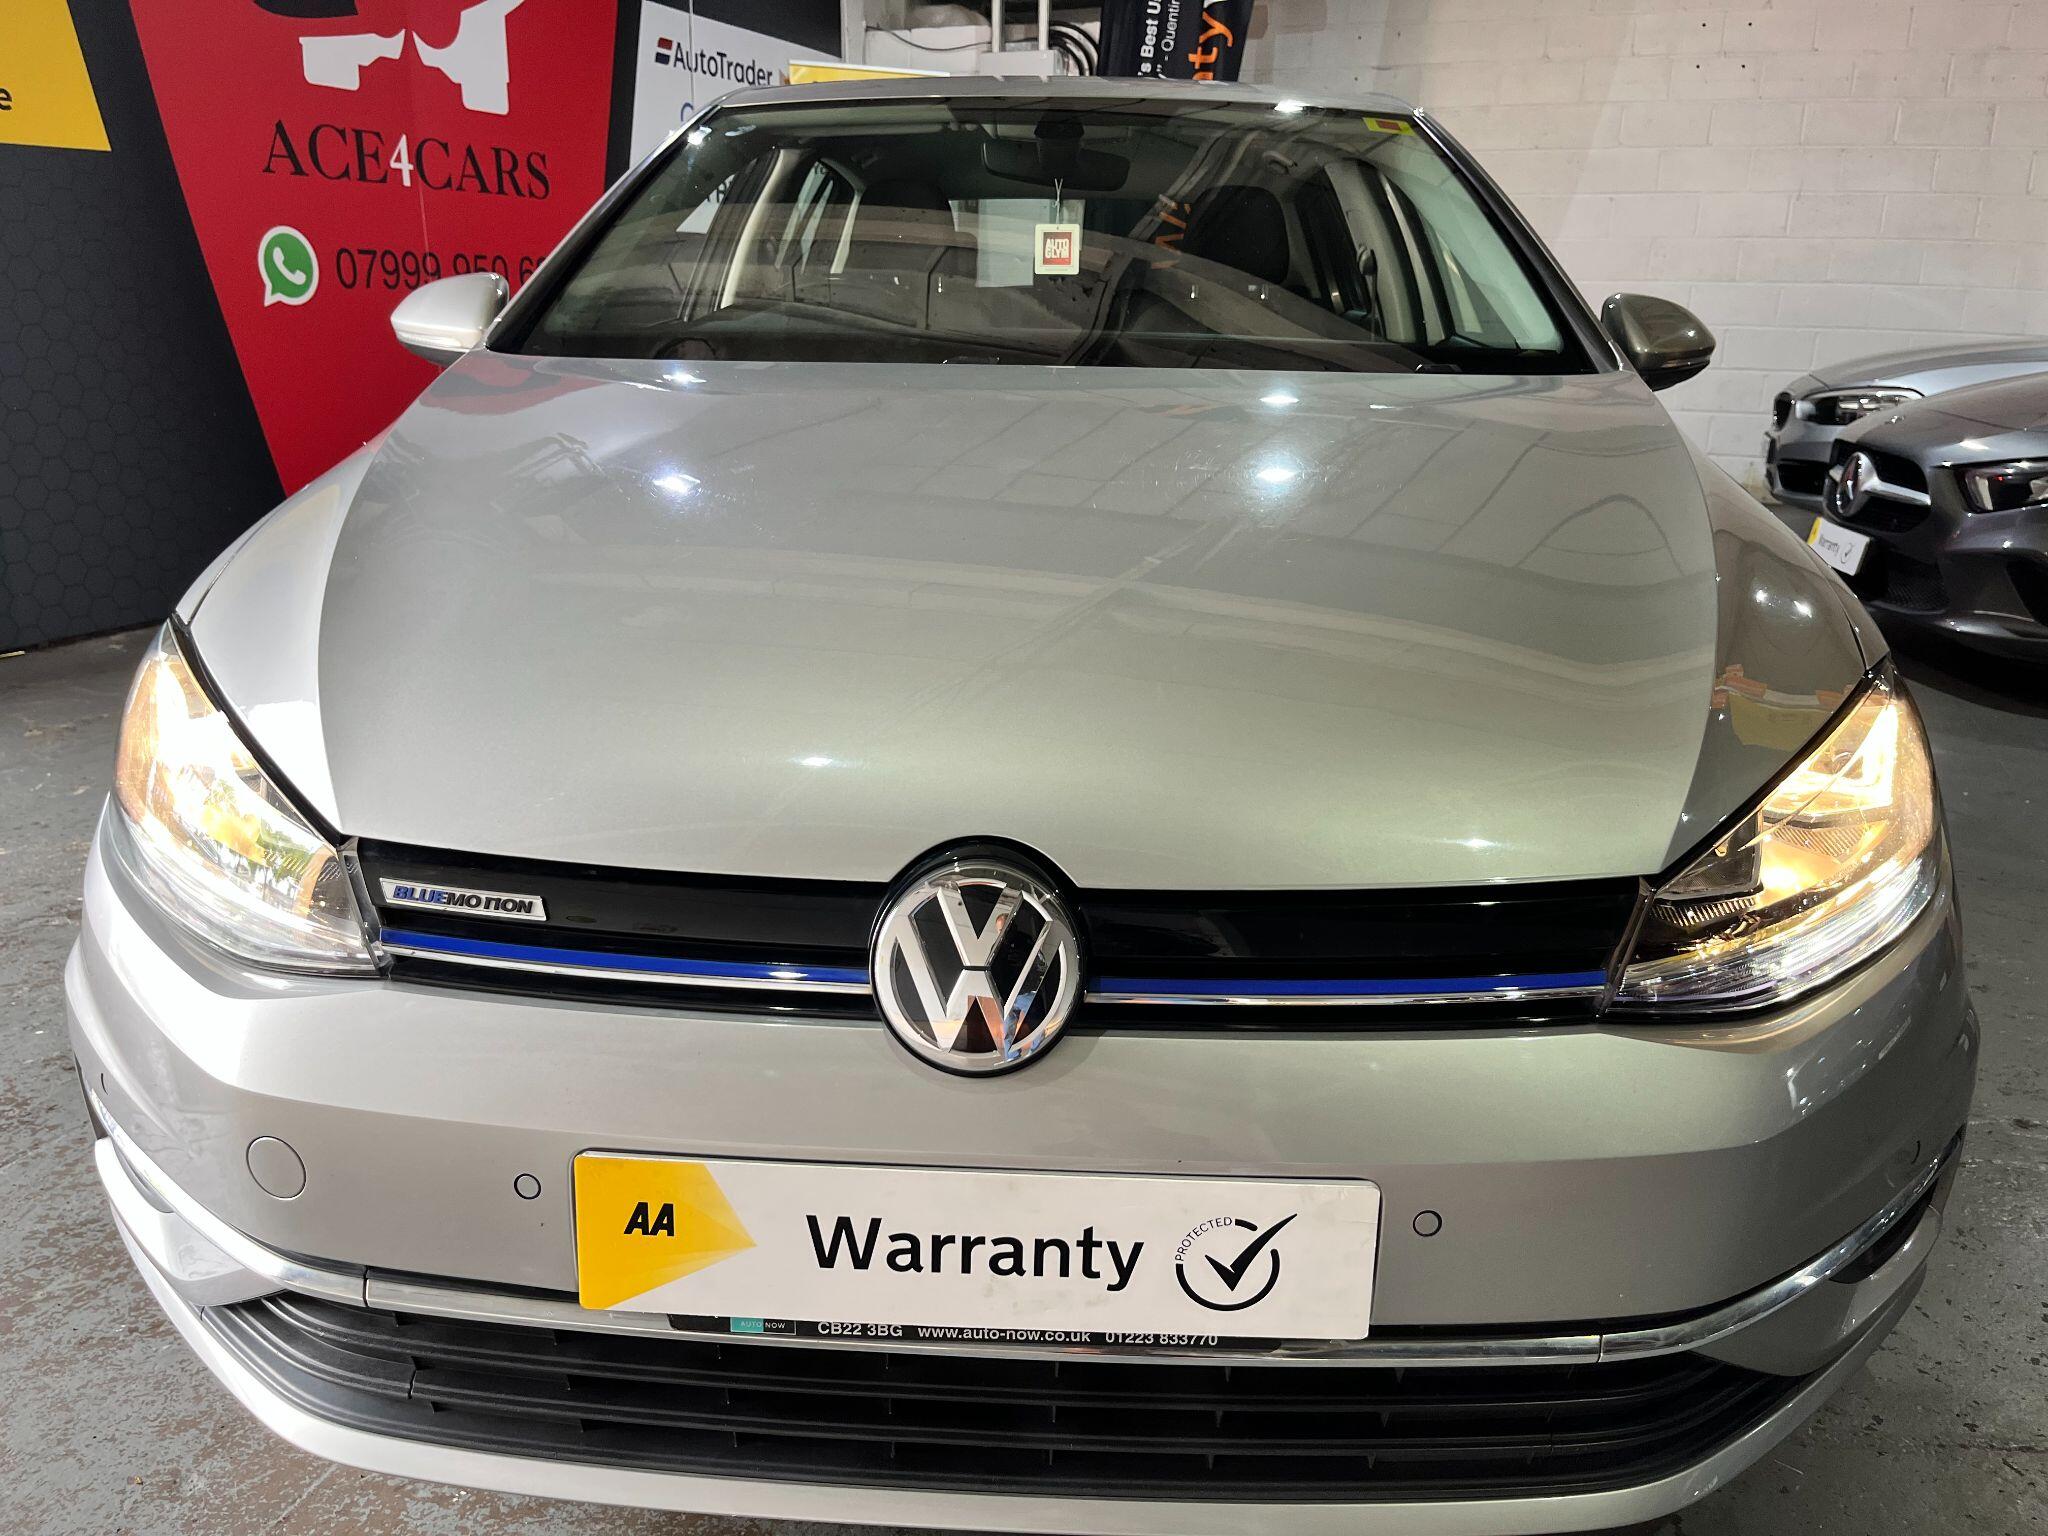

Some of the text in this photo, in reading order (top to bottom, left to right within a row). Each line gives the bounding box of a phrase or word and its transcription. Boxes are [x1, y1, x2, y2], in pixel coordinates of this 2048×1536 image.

[1140, 18, 1159, 58] Best
[673, 42, 773, 86] AutoTrader
[262, 119, 550, 200] ACE4CARS
[1045, 238, 1070, 248] AUTO
[393, 885, 533, 914] BLUEMOTION
[624, 1201, 676, 1237] AA
[805, 1214, 1145, 1292] Warranty
[1174, 1216, 1233, 1263] PROTECTED
[764, 1321, 787, 1329] NOW
[817, 1320, 862, 1336] CB22
[867, 1323, 903, 1337] 3BG
[917, 1325, 1091, 1342] www.auto-now.co.uk
[1105, 1332, 1154, 1344] 01223
